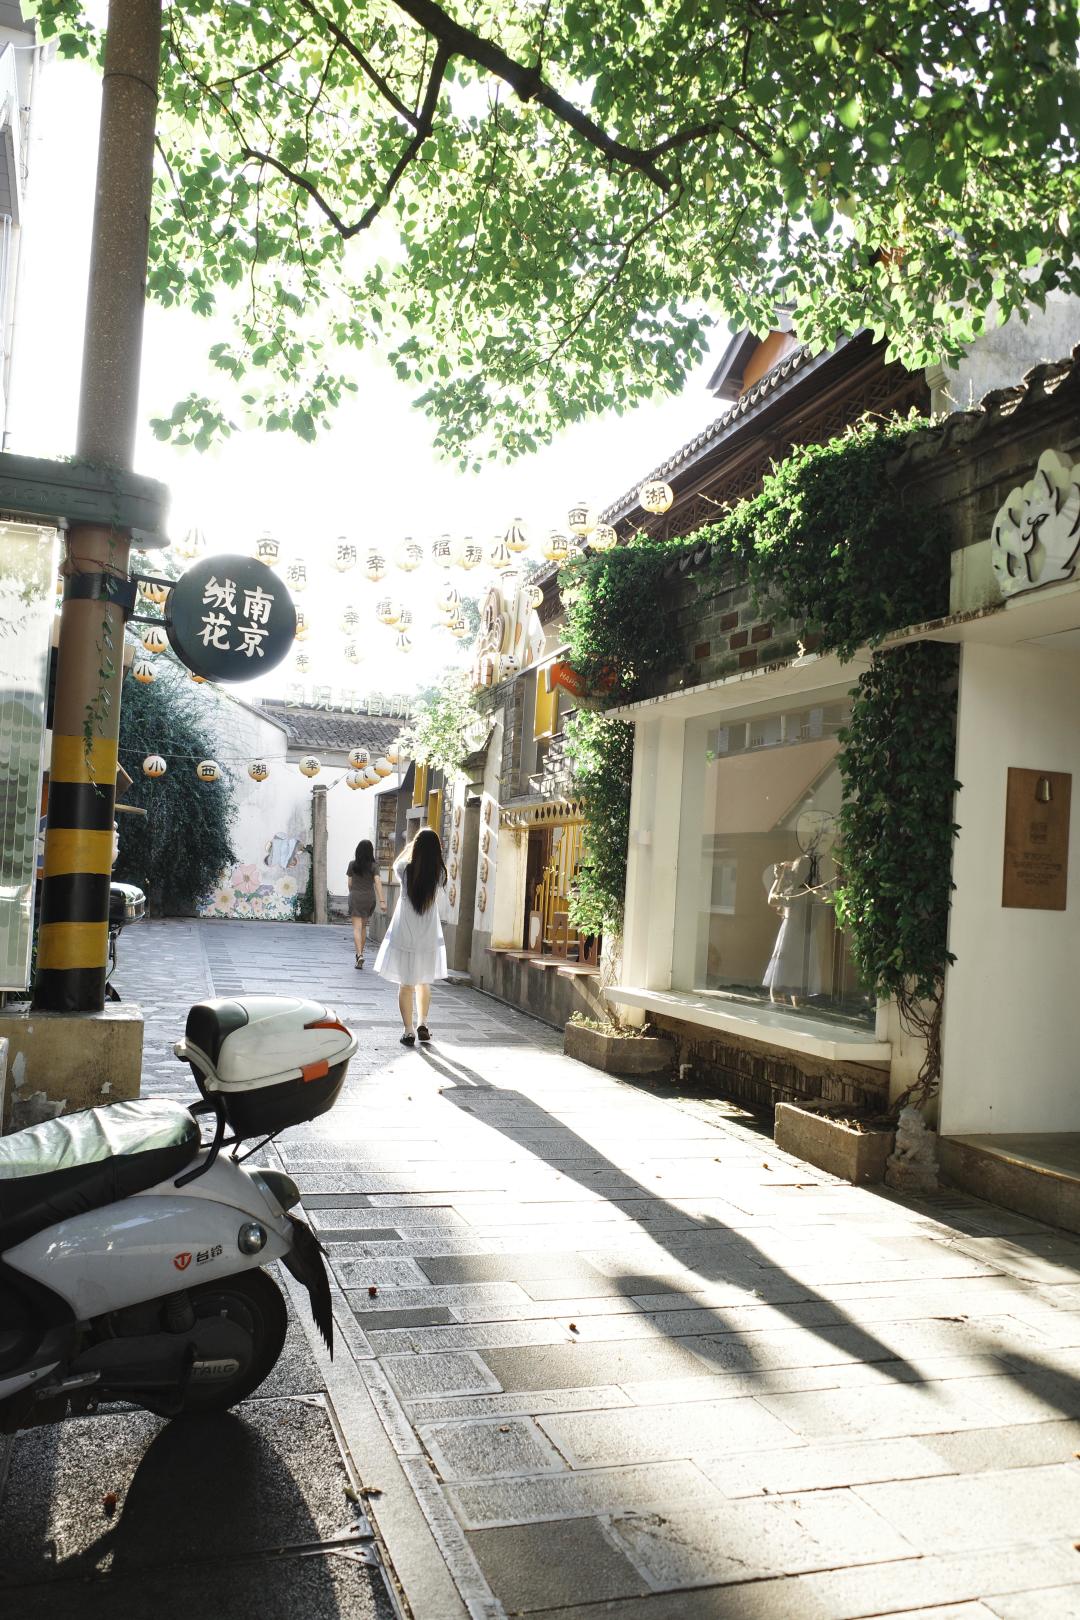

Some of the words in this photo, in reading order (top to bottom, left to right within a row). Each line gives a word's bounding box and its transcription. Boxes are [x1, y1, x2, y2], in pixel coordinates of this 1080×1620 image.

[645, 486, 667, 505] 湖
[568, 508, 590, 526] 西
[504, 526, 526, 543] 小
[550, 535, 568, 550] 西
[256, 538, 280, 558] 西
[337, 544, 356, 563] 湖
[432, 540, 451, 557] 福
[465, 546, 482, 562] 福
[490, 544, 511, 560] 小
[366, 555, 385, 572] 幸
[286, 565, 307, 583] 湖
[196, 576, 237, 650] 绒花
[235, 586, 274, 658] 南京
[144, 631, 163, 645] 小
[136, 664, 153, 676] 小
[148, 760, 164, 773] 小
[305, 760, 319, 771] 幸
[354, 752, 367, 764] 福
[201, 764, 216, 777] 西
[252, 764, 267, 776] 湖
[196, 1244, 223, 1263] 台铃
